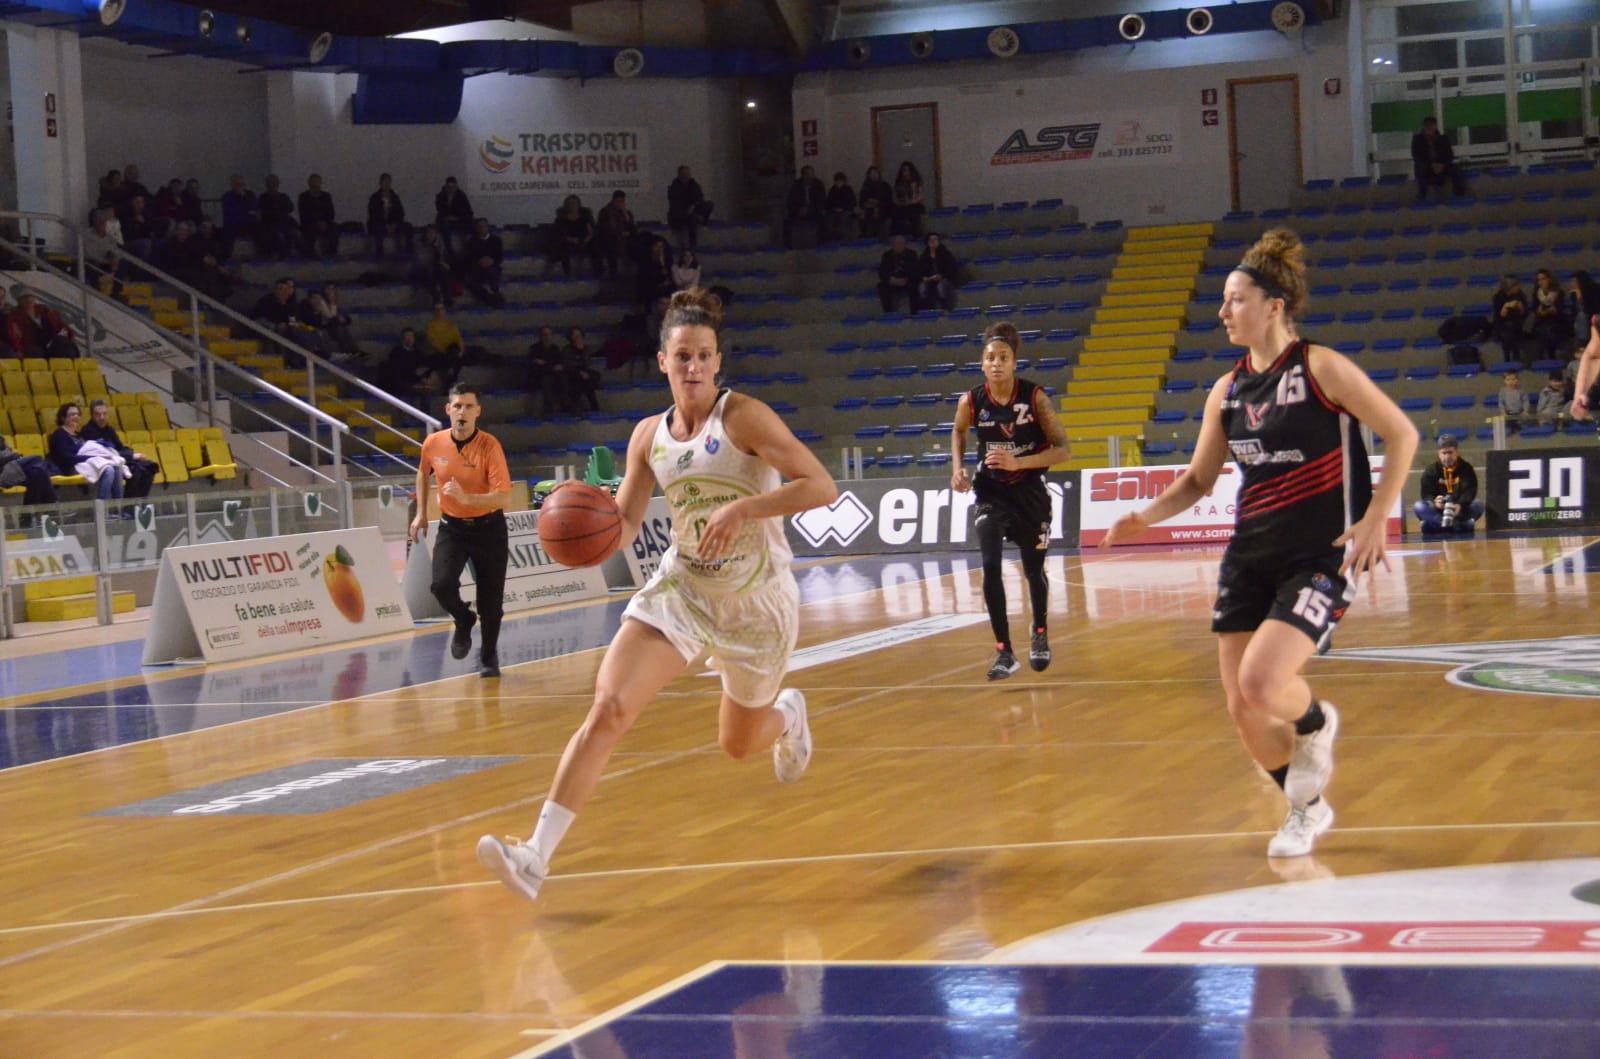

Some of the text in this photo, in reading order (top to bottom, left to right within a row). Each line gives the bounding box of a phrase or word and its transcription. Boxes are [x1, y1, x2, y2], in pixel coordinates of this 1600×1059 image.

[519, 132, 638, 152] TRASPORTI
[993, 123, 1101, 155] ASG
[521, 154, 639, 176] KAMARINA
[1276, 364, 1306, 406] 15
[1508, 457, 1583, 509] 2.0
[1193, 504, 1236, 516] RAG
[1508, 510, 1583, 521] DUEPUNTOZERO
[181, 551, 294, 584] MULTIFIDI
[192, 585, 237, 600] CONSORZIO
[247, 580, 284, 593] GARANZIA
[235, 603, 248, 622] fa
[248, 603, 277, 620] bene
[291, 598, 316, 613] salute
[1291, 587, 1333, 628] 15
[1200, 926, 1600, 949] DE
